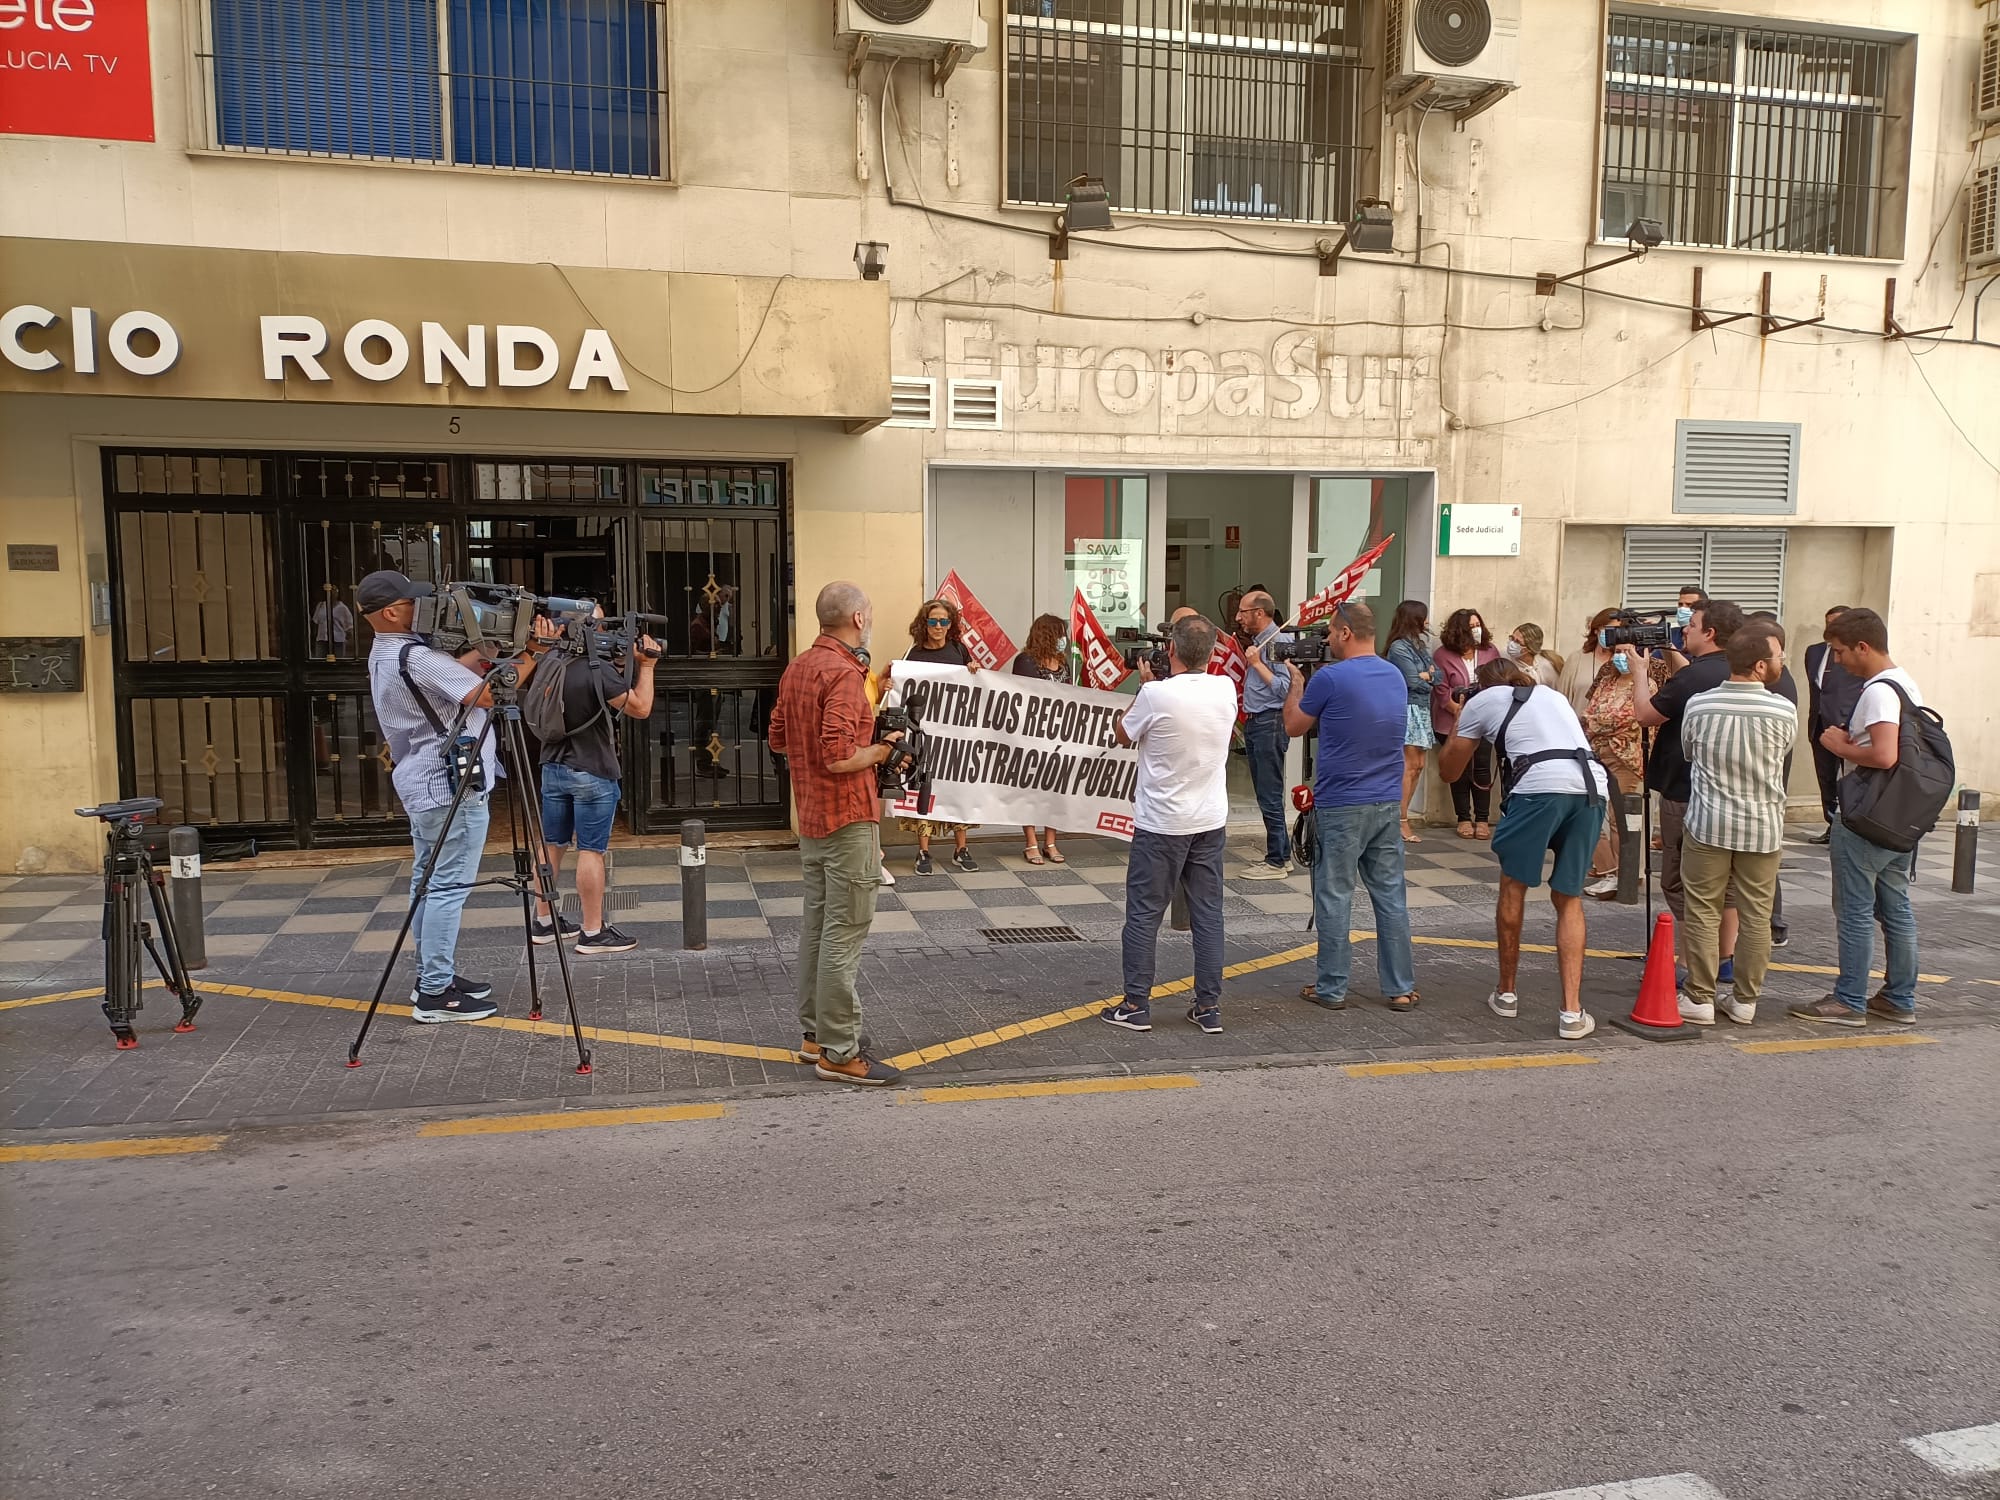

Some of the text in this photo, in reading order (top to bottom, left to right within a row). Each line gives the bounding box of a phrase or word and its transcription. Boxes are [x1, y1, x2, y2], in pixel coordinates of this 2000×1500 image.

[83, 54, 118, 73] TV
[0, 303, 631, 391] CIO RONDA
[944, 317, 1438, 435] EuropaSur
[448, 416, 461, 435] 5
[1456, 524, 1504, 534] Sede Judicial
[1087, 543, 1120, 556] SAVA
[901, 677, 1118, 750] CONTRA LOS RECORTES
[908, 734, 1077, 795] MINISTRACIÓN
